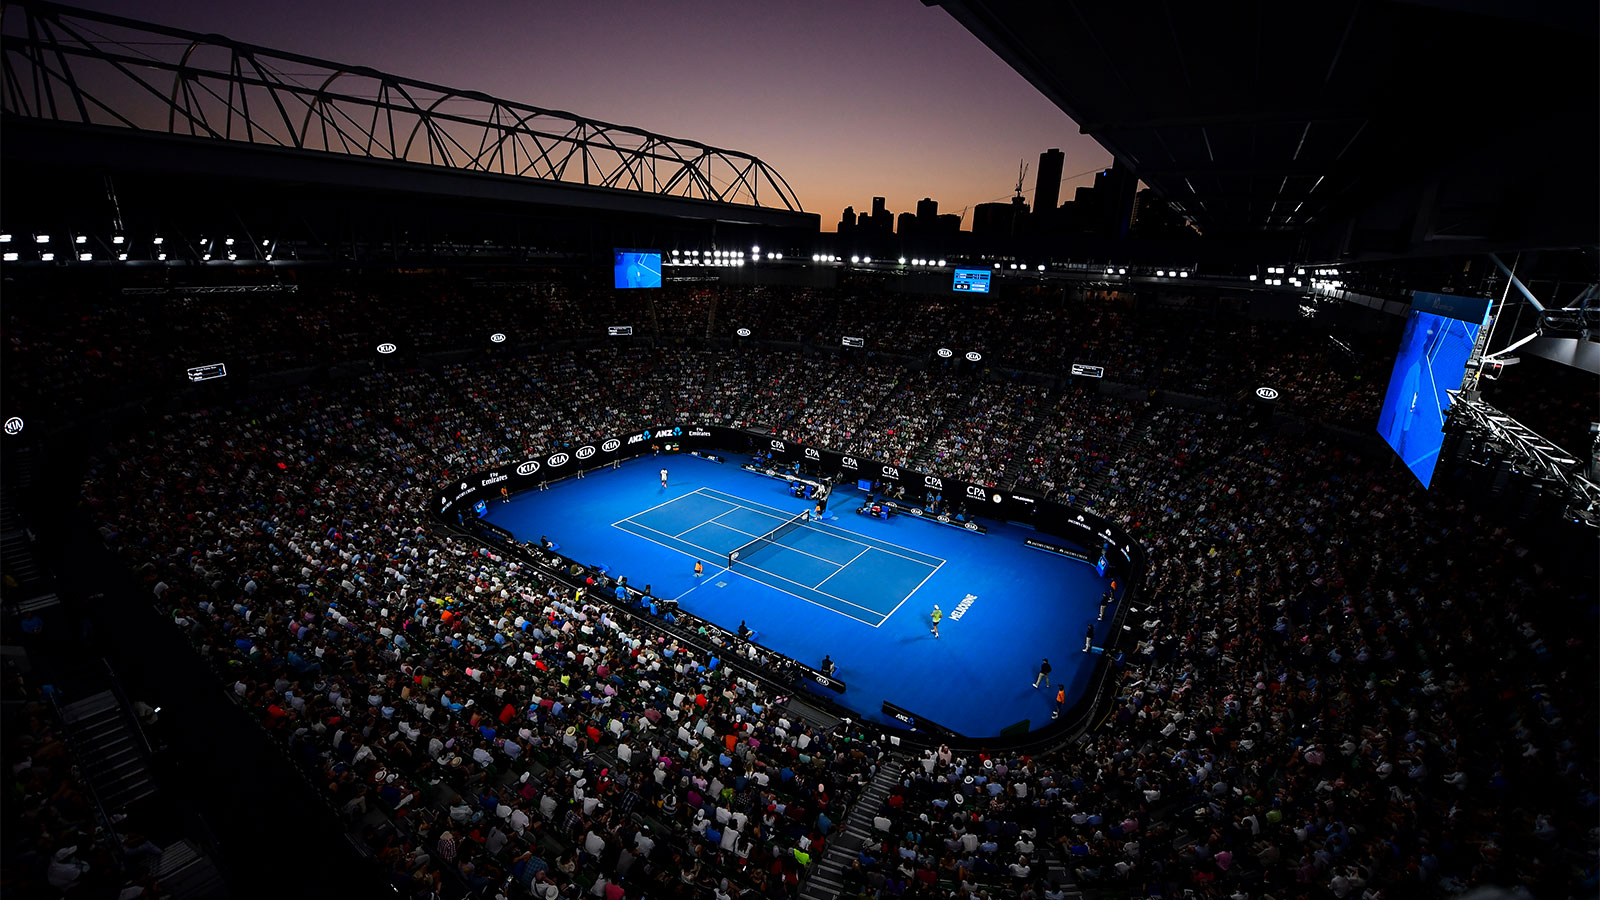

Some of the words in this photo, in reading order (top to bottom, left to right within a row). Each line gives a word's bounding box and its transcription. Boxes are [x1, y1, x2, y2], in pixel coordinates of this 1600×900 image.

[628, 434, 643, 444] ANZ
[655, 430, 673, 438] ANZ
[603, 440, 618, 451] KIA
[771, 440, 785, 449] CPA
[578, 447, 594, 458] KIA
[805, 448, 820, 458] CPA
[549, 454, 567, 466] KIA
[842, 457, 858, 467] CPA
[519, 462, 538, 474] KIA
[882, 466, 899, 477] CPA
[482, 475, 508, 486] Emirates
[924, 476, 942, 487] CPA
[967, 486, 985, 497] CPA
[896, 713, 909, 723] ANZ
